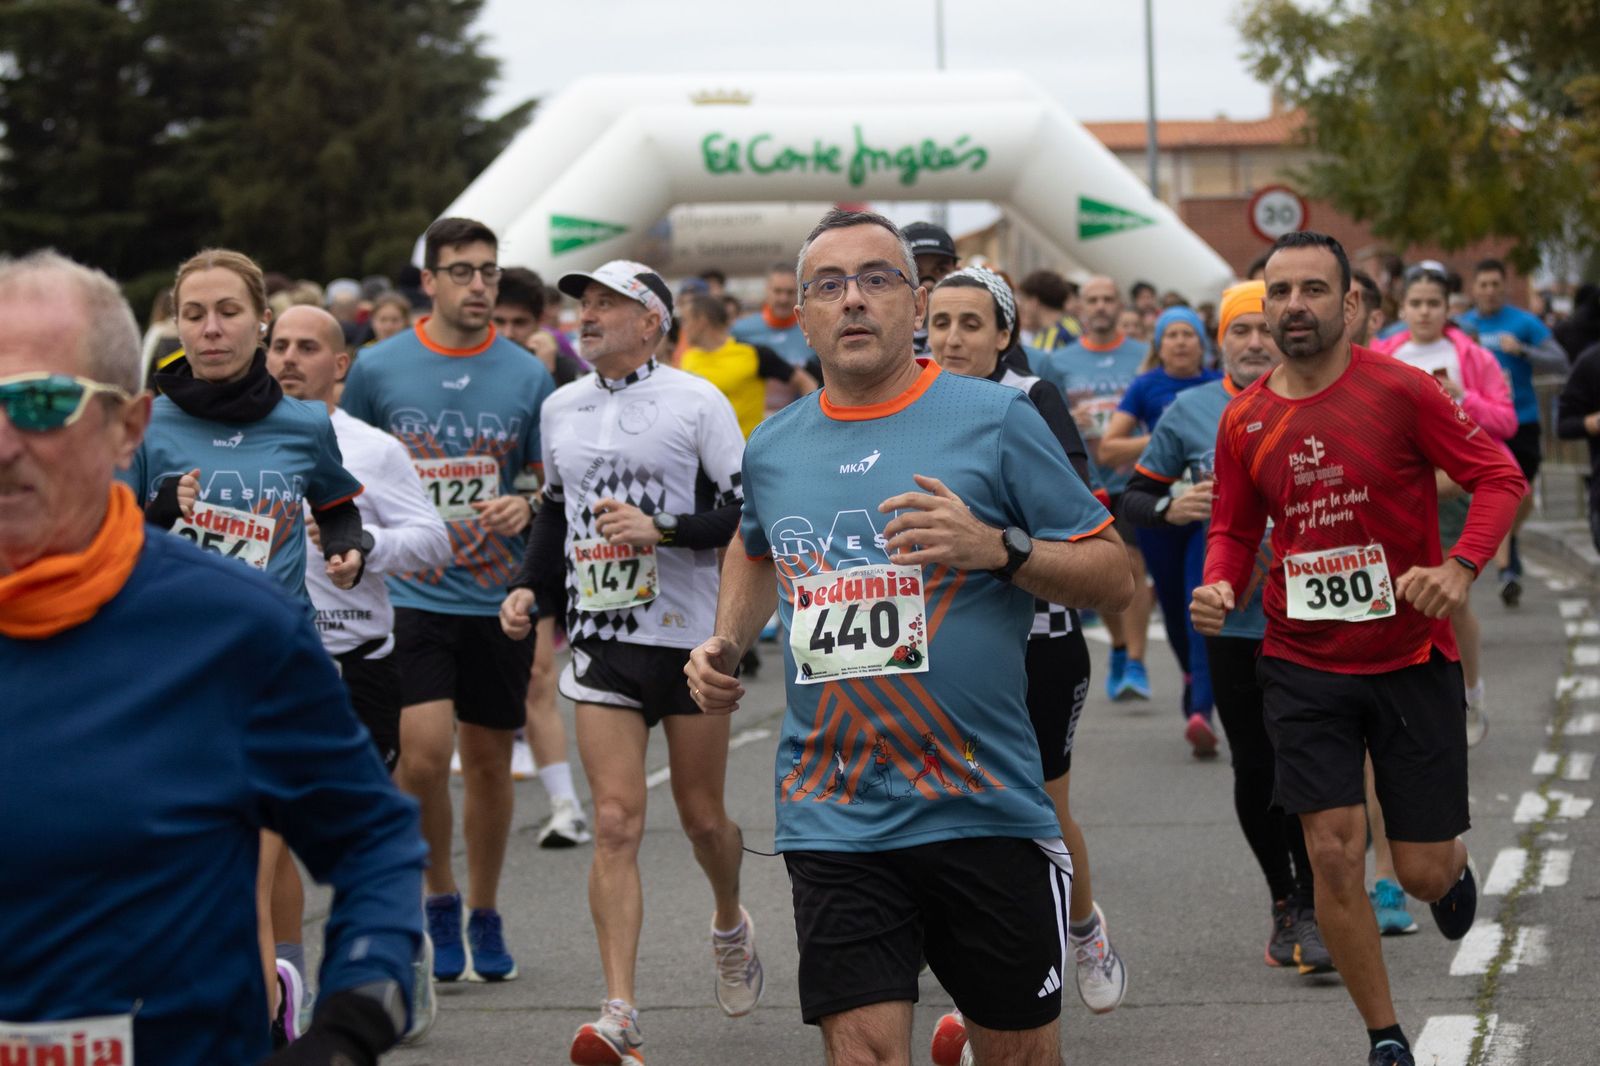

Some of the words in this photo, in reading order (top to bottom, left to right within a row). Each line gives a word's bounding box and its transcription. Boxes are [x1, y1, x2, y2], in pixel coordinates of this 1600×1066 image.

[702, 133, 742, 174] El
[747, 133, 842, 175] Corte
[848, 124, 988, 187] Inglés
[1262, 205, 1295, 226] 30
[839, 462, 866, 475] MKA
[428, 478, 484, 507] 122
[183, 509, 270, 543] edunia
[588, 559, 640, 594] 147
[1287, 548, 1384, 577] bedunia
[797, 571, 920, 612] bedunia
[1305, 570, 1374, 610] 380
[316, 609, 373, 621] ILVESTRE
[809, 600, 900, 655] 440
[0, 1032, 123, 1066] unia
